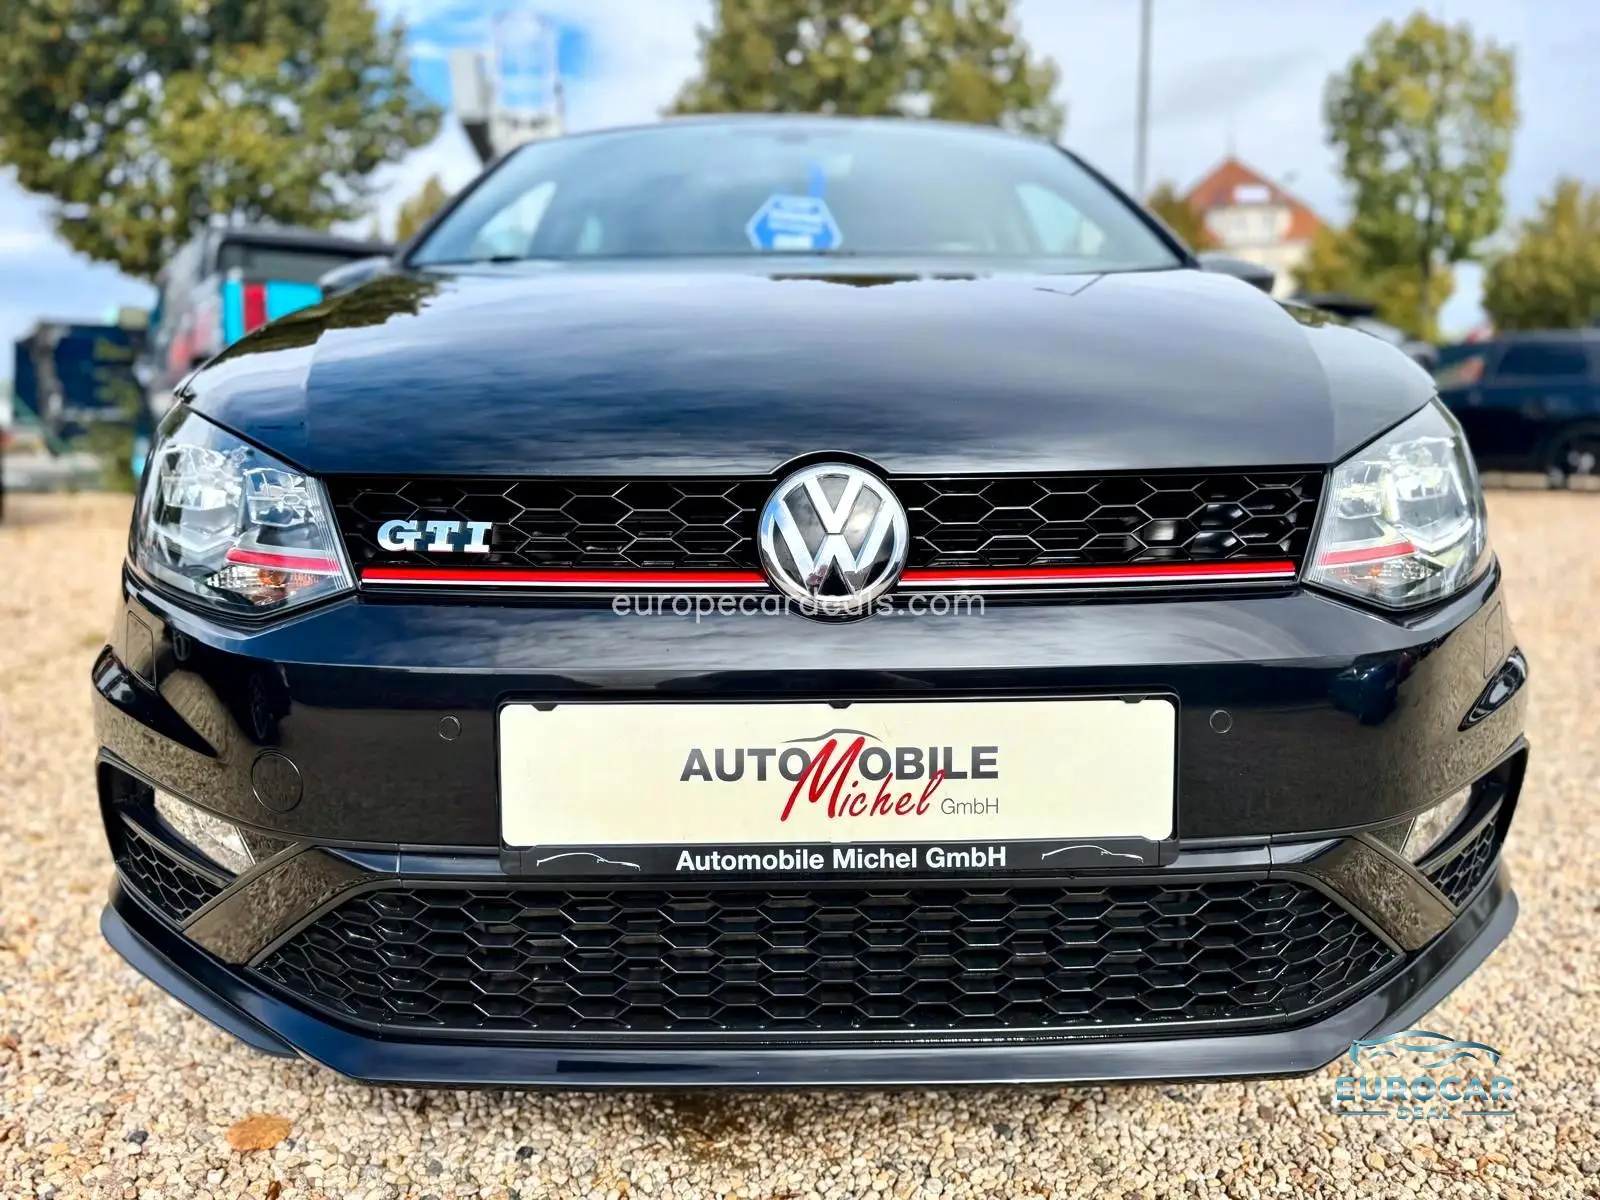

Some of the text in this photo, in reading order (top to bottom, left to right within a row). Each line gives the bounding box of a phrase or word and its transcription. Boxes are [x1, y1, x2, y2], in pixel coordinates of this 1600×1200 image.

[377, 519, 493, 553] GTI
[680, 744, 999, 782] AUTOMOBILE
[780, 736, 999, 822] Michel GmbH
[675, 846, 1007, 871] Automobile Michel GmbH
